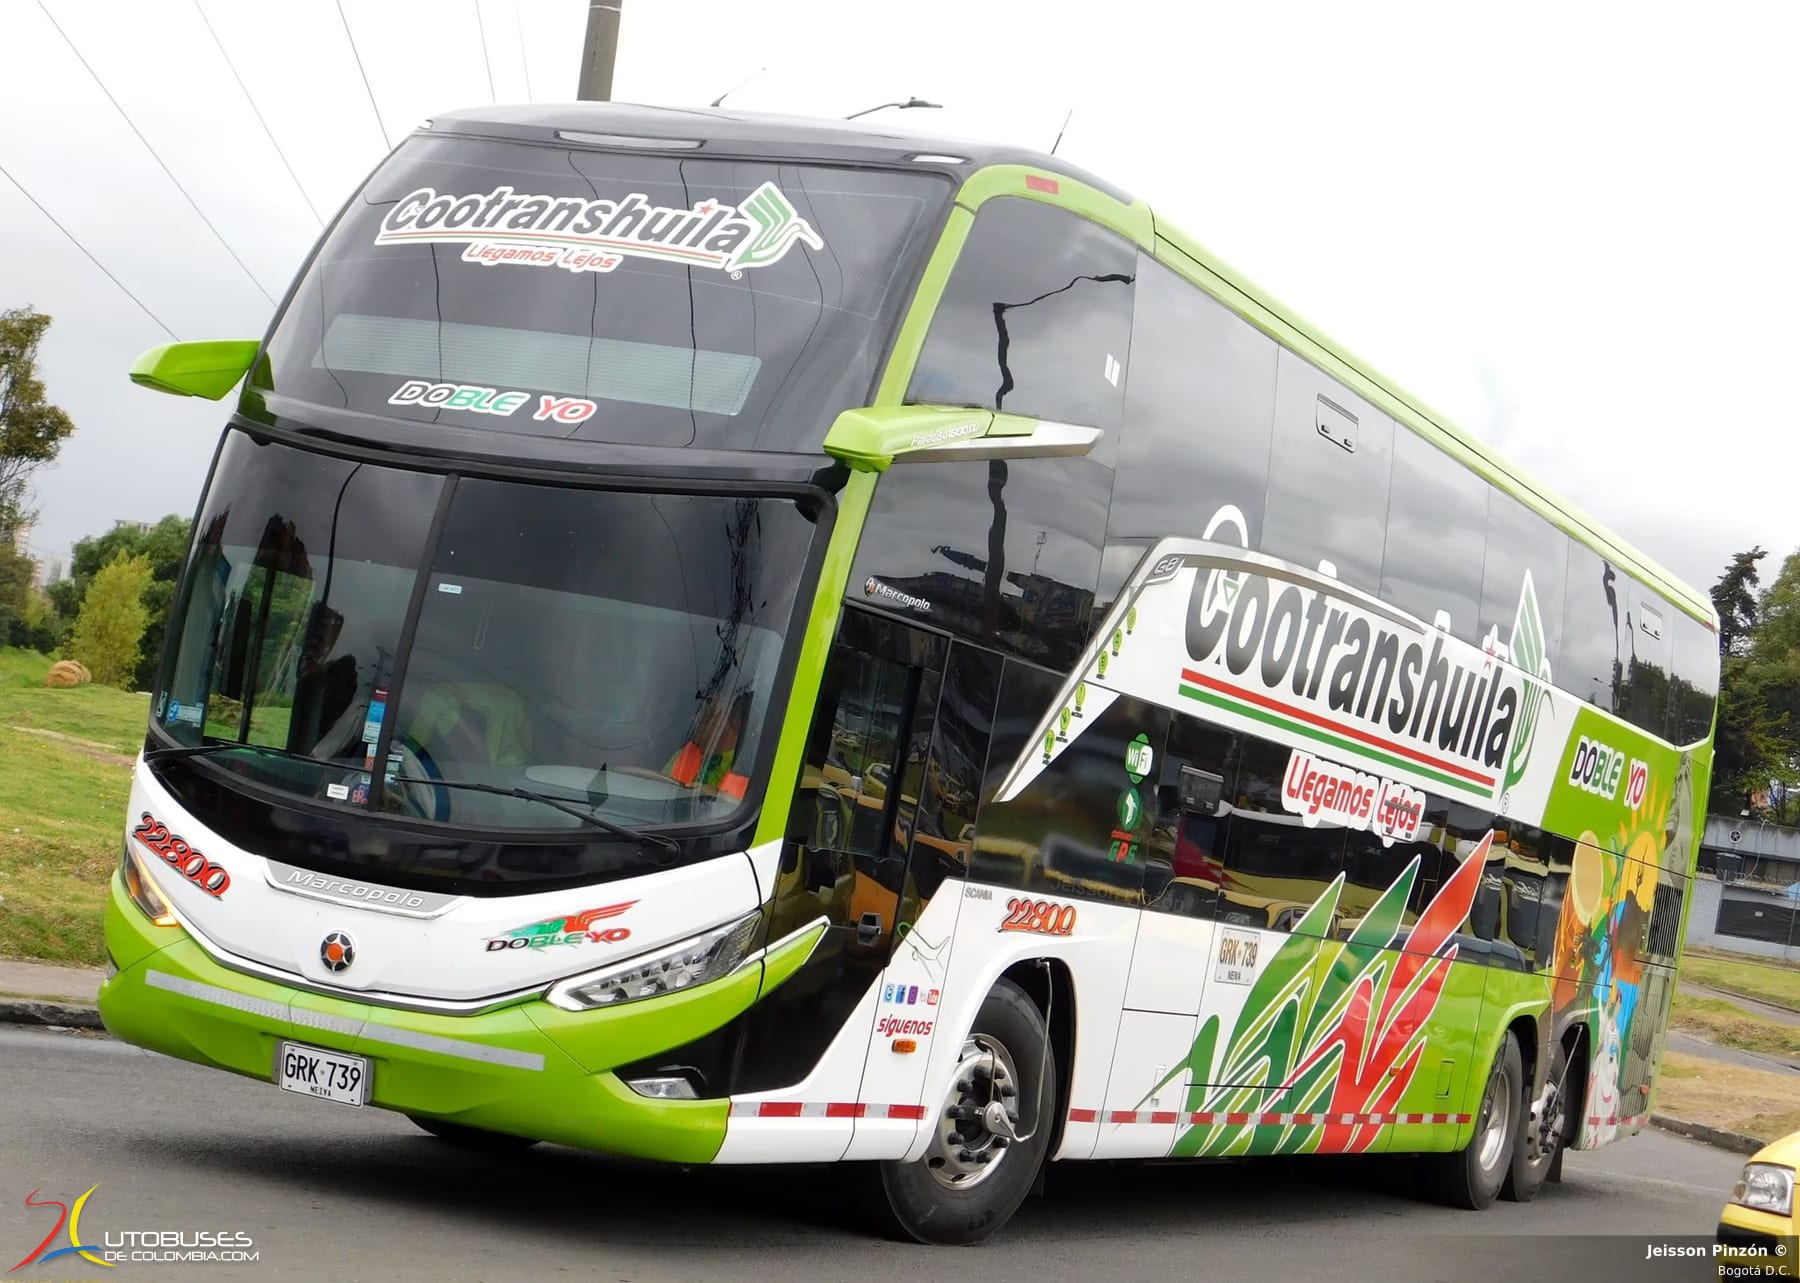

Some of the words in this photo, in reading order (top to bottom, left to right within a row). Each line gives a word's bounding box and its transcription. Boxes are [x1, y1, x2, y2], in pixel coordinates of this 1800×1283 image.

[384, 188, 752, 255] Cootranshuila
[465, 243, 558, 263] Llegamos
[561, 248, 619, 269] Lejos
[390, 382, 528, 413] DOBLE
[537, 398, 594, 421] YO
[875, 583, 931, 610] Marcopolo
[1184, 517, 1518, 771] Cootranshuila
[1570, 741, 1623, 795] DOBLE
[1625, 763, 1647, 805] YO
[1286, 755, 1375, 818] Llegamos
[1376, 783, 1422, 835] Lejos
[131, 811, 231, 901] 22800
[1107, 841, 1138, 865] GPS
[286, 870, 424, 908] Marcopolo
[964, 887, 993, 901] SCANIA
[999, 896, 1077, 936] 22800
[485, 932, 585, 952] DOBLE
[1220, 938, 1239, 966] GRK
[1241, 941, 1258, 969] 739
[284, 1053, 320, 1084] GRK
[326, 1061, 361, 1092] 739
[310, 1086, 331, 1097] NEIVA
